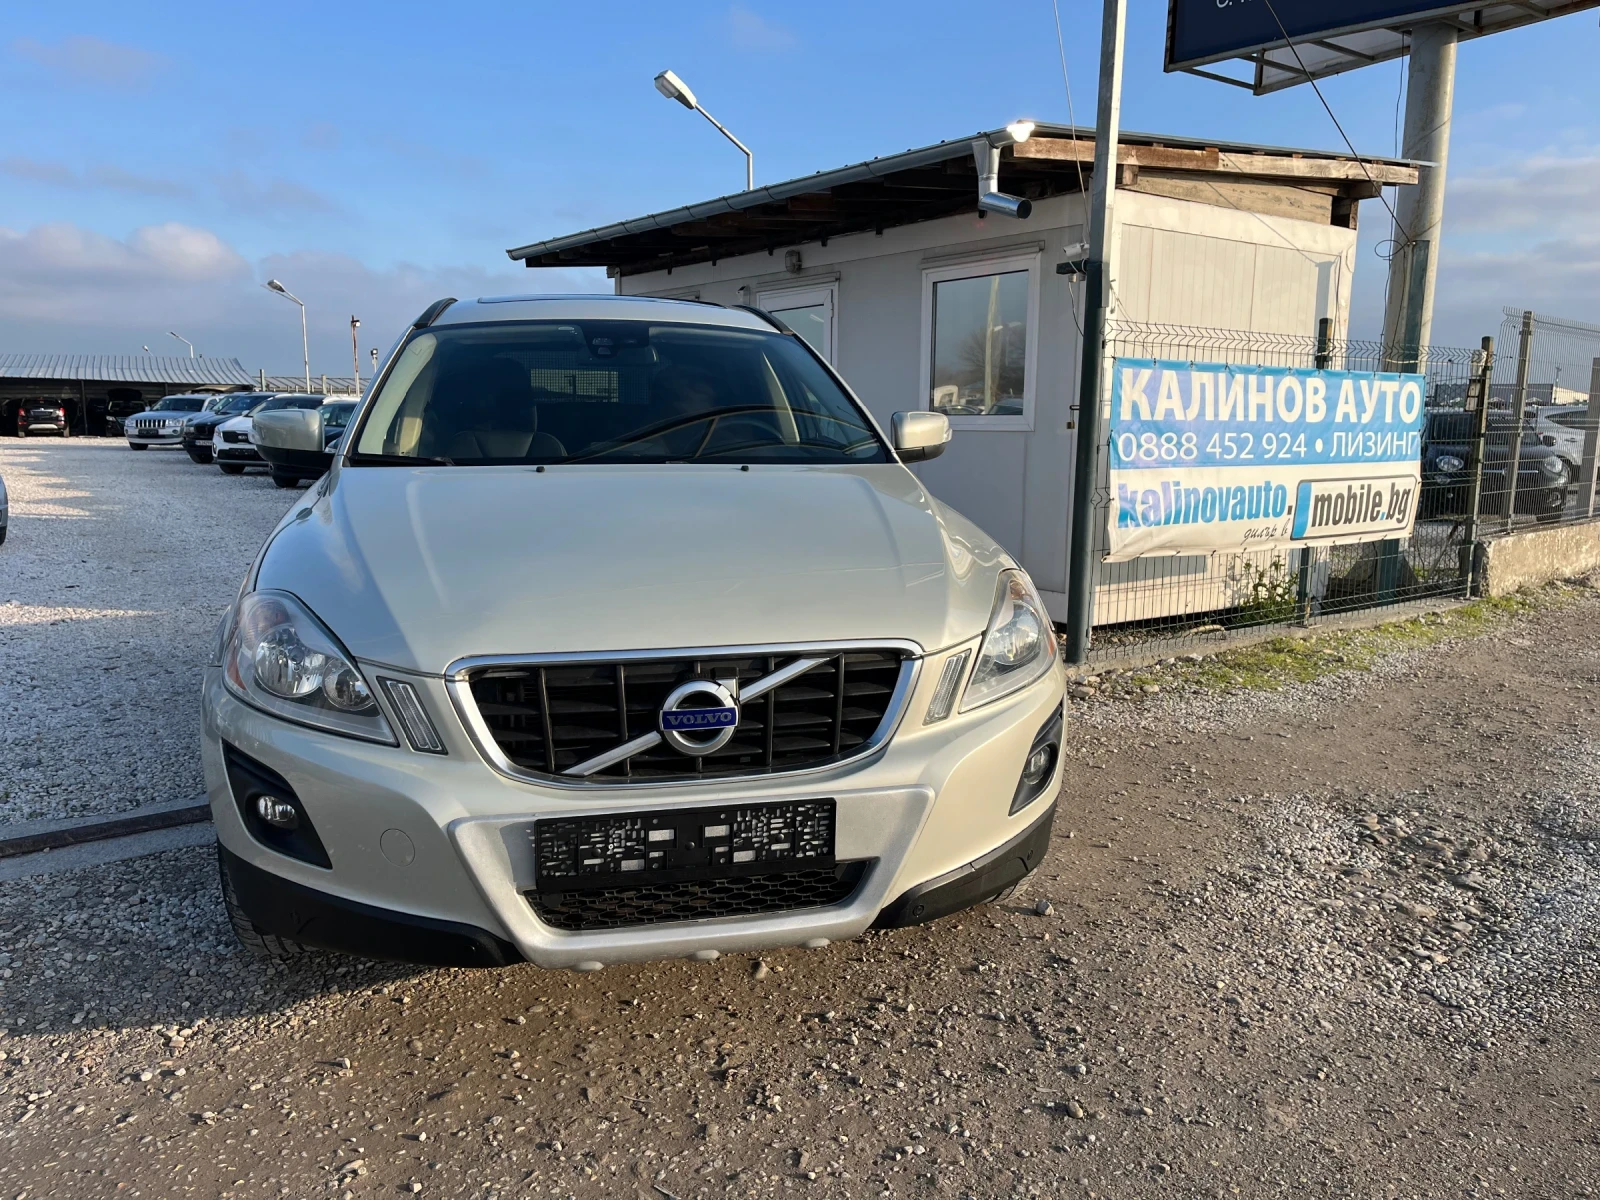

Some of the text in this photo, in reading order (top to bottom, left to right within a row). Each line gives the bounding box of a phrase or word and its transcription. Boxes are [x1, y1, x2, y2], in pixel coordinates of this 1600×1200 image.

[1119, 368, 1421, 424] КАЛИНОВ АУТО
[1117, 431, 1418, 461] 0888 452 924 ЛИЗИНГ
[1311, 482, 1412, 527] mobile.bg
[666, 712, 732, 725] VOLVO
